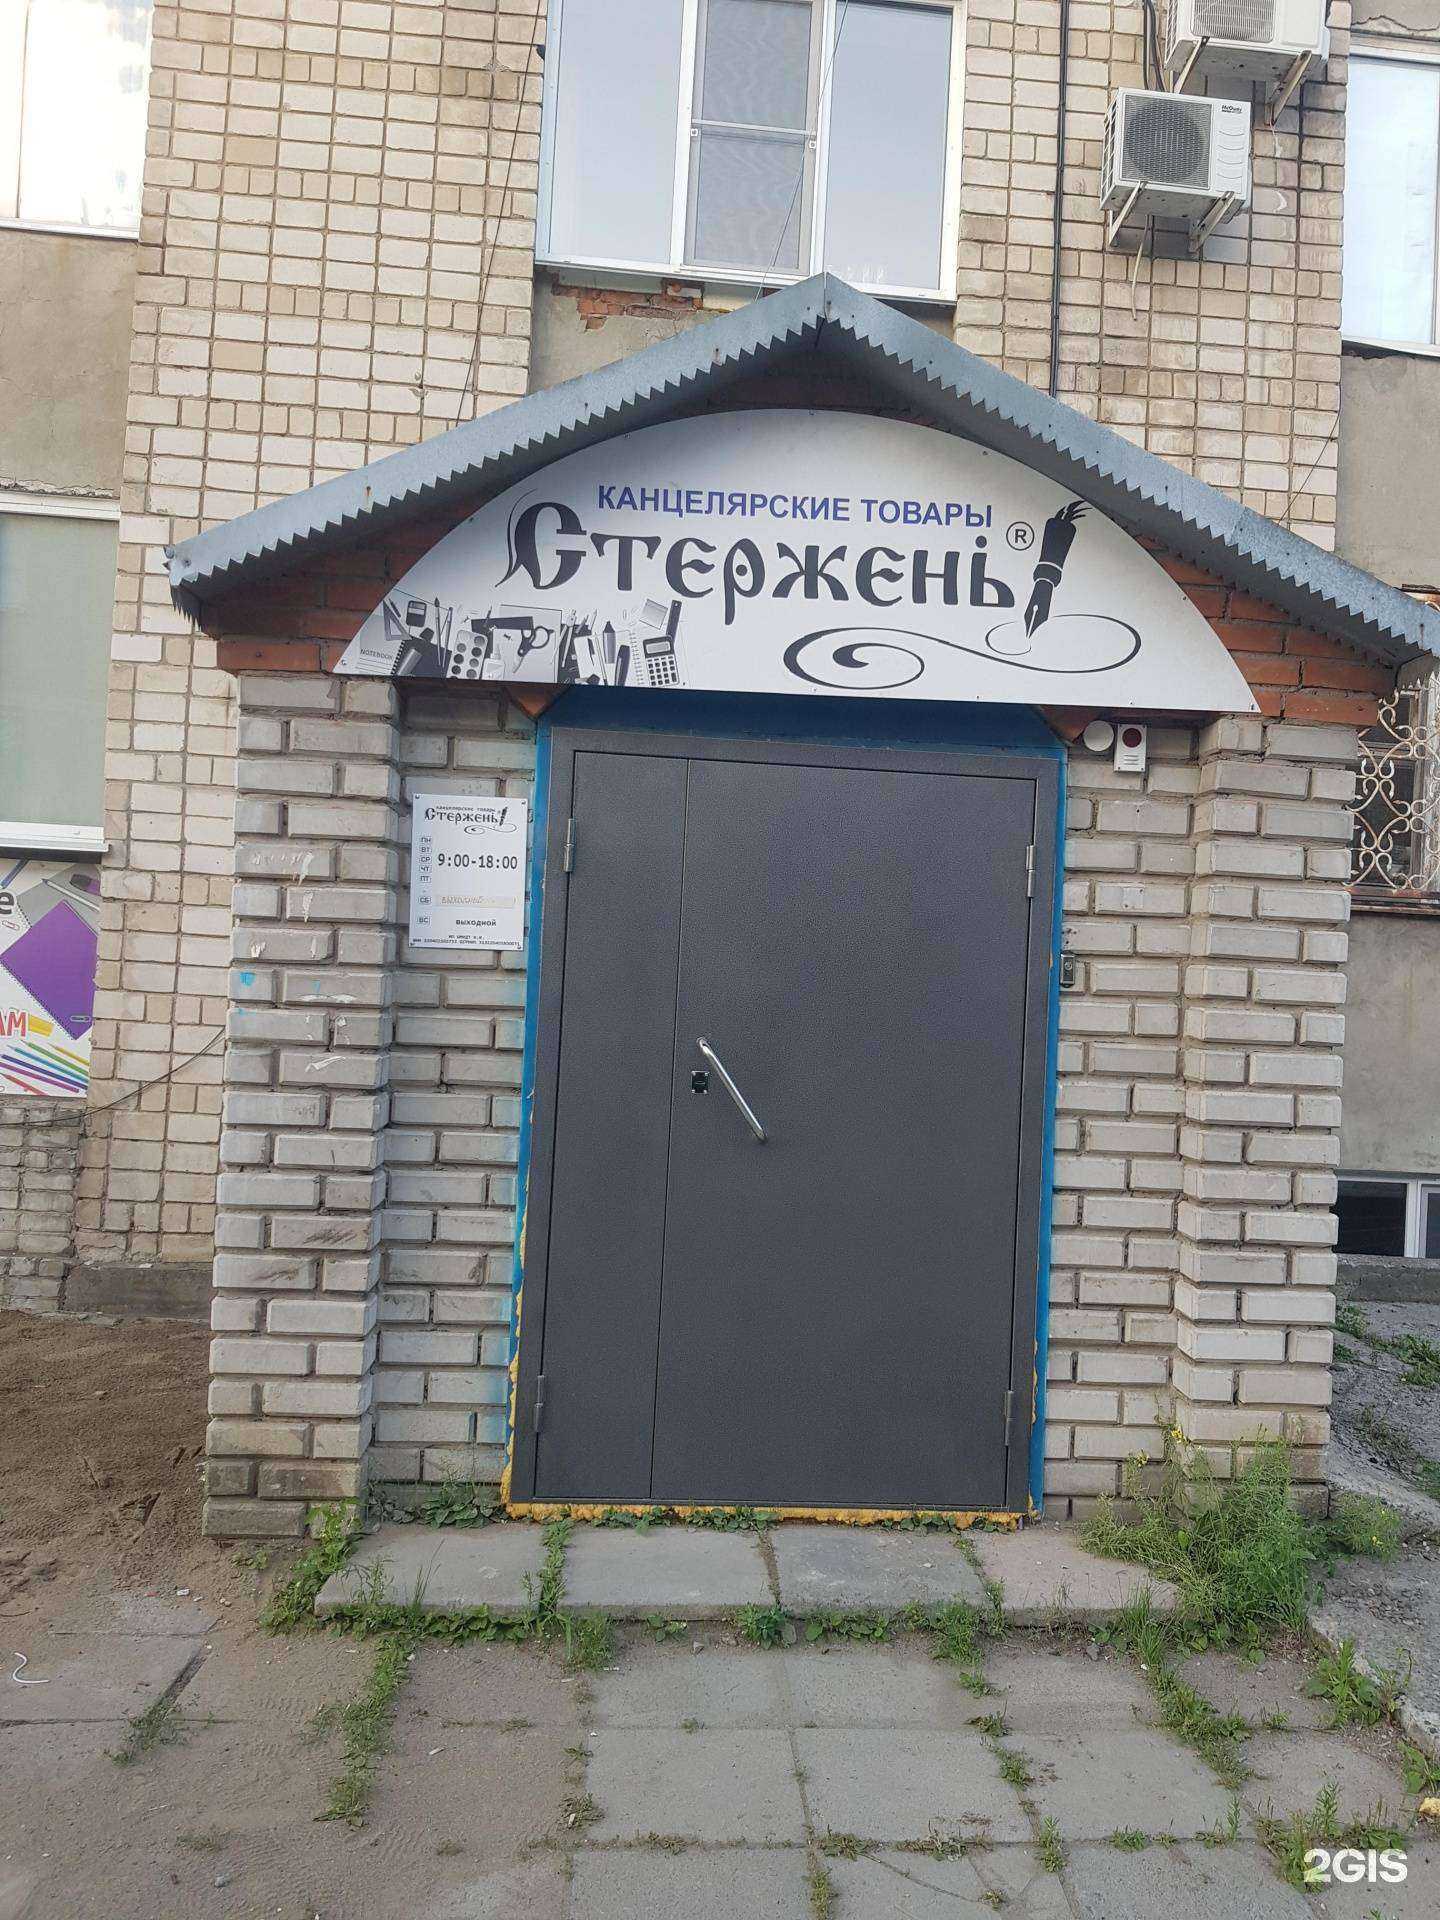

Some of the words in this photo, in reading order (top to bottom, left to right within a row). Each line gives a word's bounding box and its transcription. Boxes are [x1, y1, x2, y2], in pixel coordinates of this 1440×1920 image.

[597, 484, 850, 522] КАНЦЕЛЯРСКИЕ
[860, 498, 992, 529] ТОВАРЫ
[437, 853, 518, 870] 9:00-18:00
